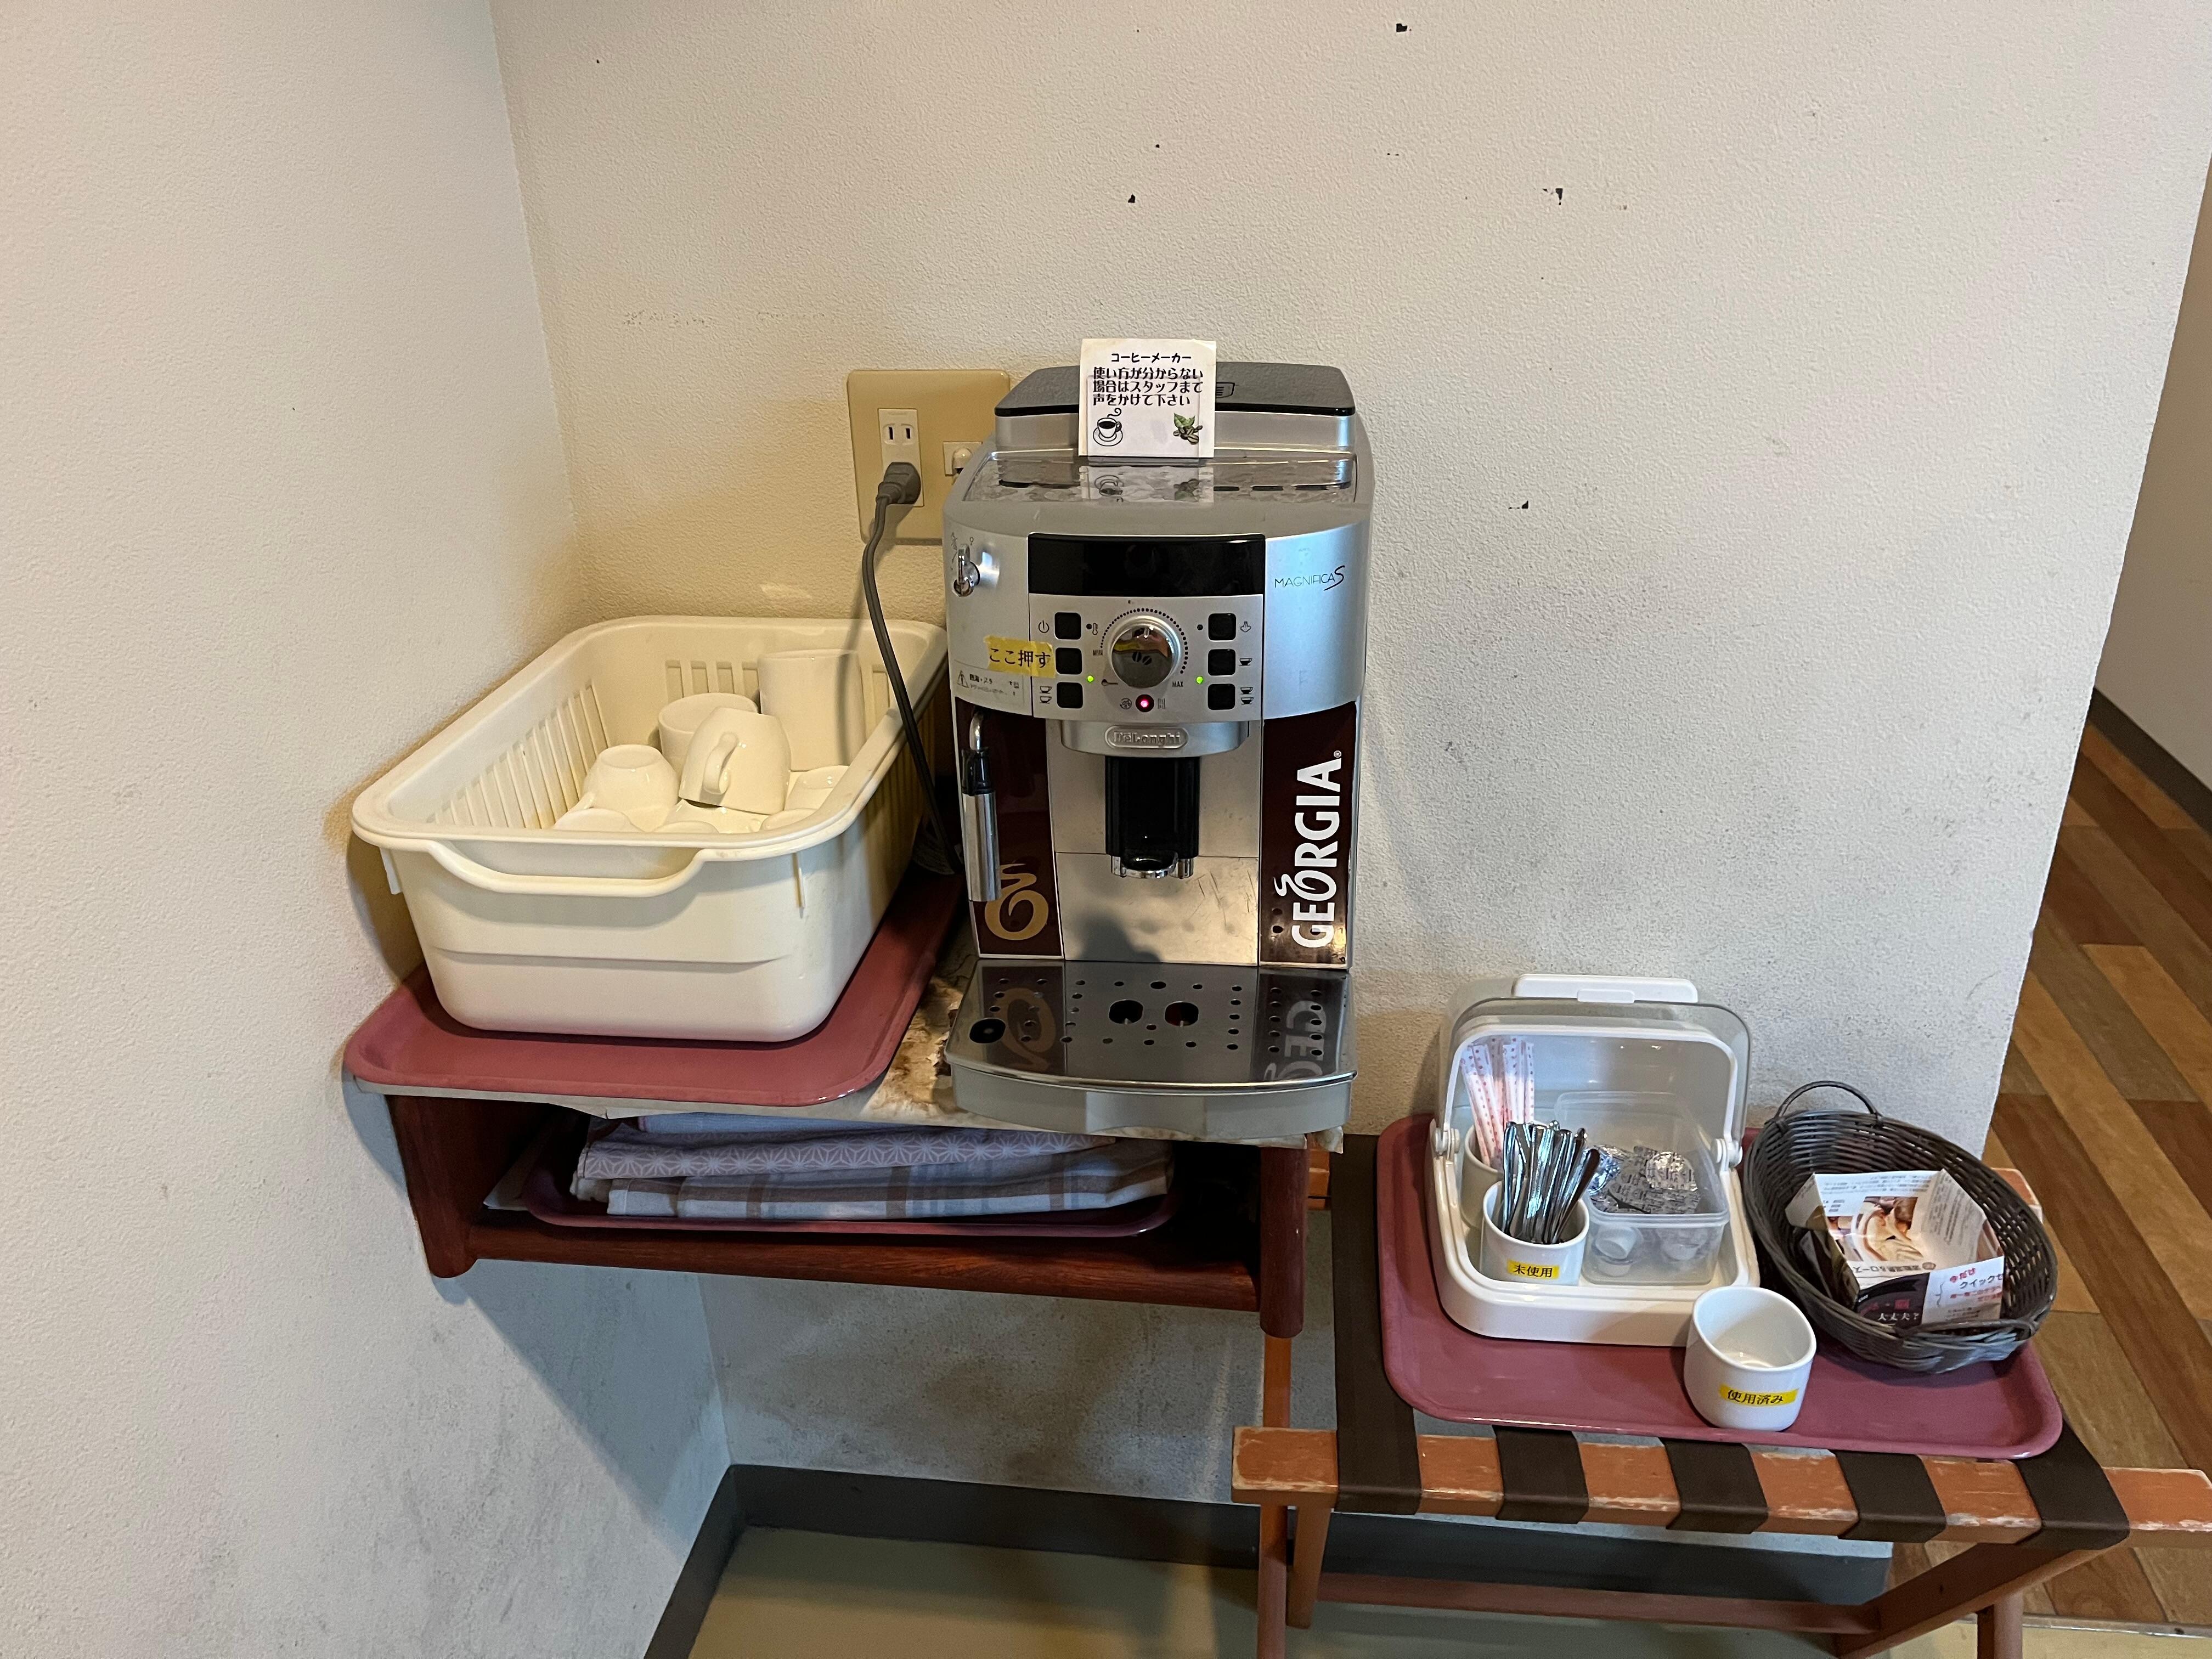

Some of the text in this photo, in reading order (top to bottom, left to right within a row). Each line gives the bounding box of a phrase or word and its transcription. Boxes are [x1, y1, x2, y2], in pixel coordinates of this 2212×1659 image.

[1111, 352, 1192, 363] コーヒーメーカー
[1093, 366, 1203, 380] 使い方が分からない
[1092, 380, 1204, 393] 場合はスタッフまで
[1092, 393, 1190, 407] 声をかけて下さい
[989, 648, 1051, 668] ここ押す
[1514, 1263, 1553, 1278] 未使用
[1727, 1389, 1784, 1405] 使用済み
